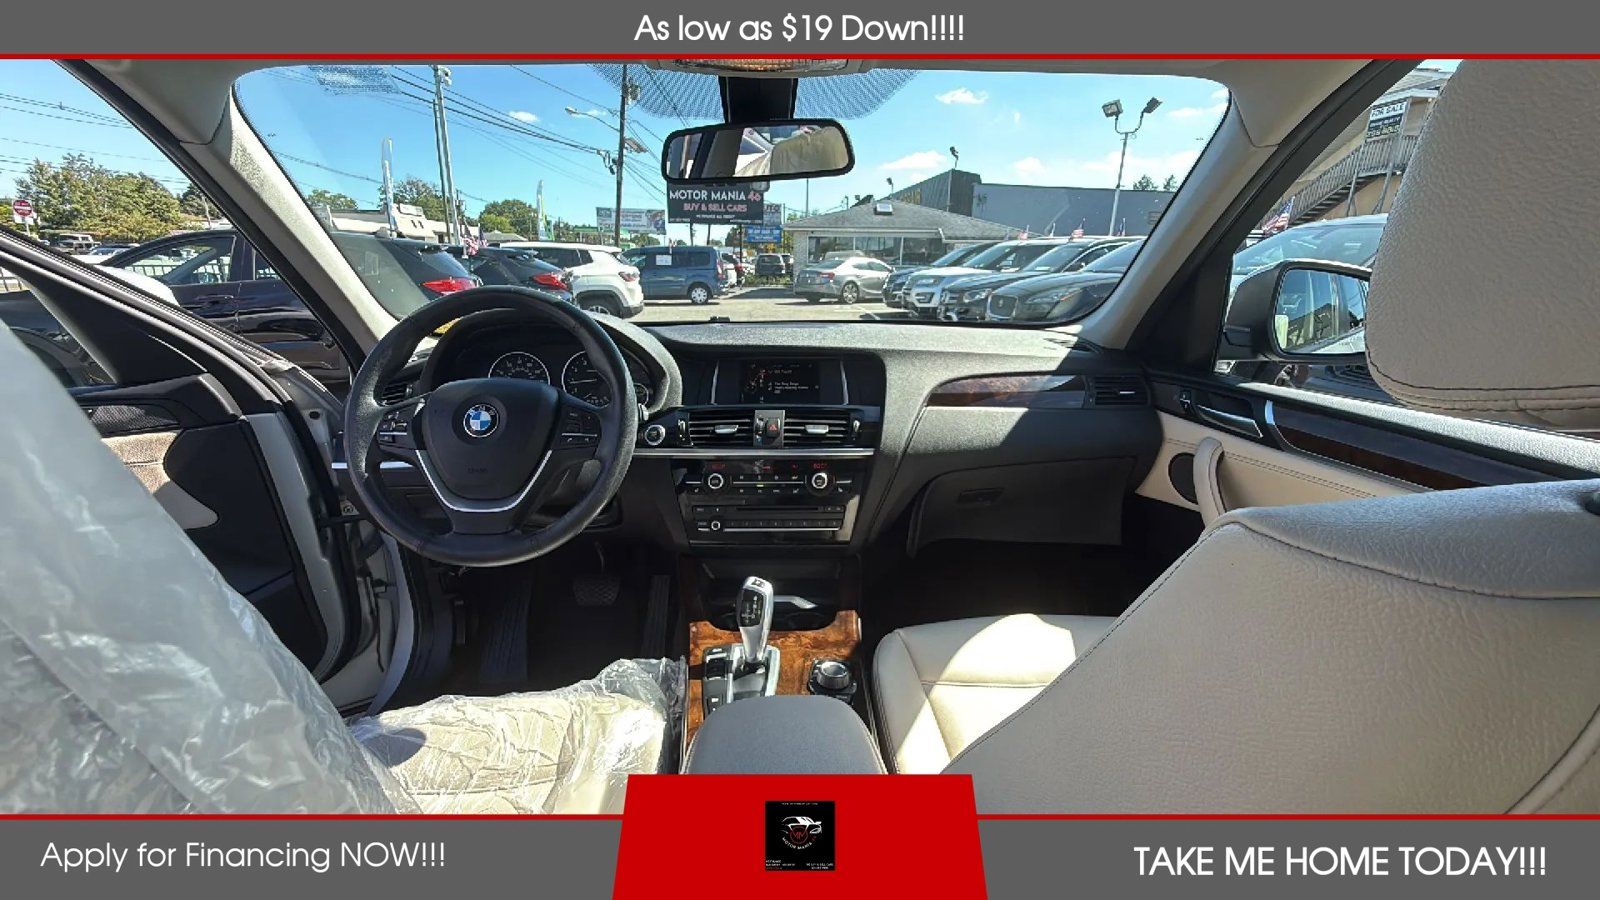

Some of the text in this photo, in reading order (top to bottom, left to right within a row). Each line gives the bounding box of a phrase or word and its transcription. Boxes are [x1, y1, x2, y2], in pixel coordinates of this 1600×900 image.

[1372, 104, 1404, 117] FOR SALE
[669, 189, 762, 202] MOTOR MANIA 46
[683, 202, 700, 212] BUY
[708, 203, 726, 212] SELL
[727, 204, 748, 213] CARS
